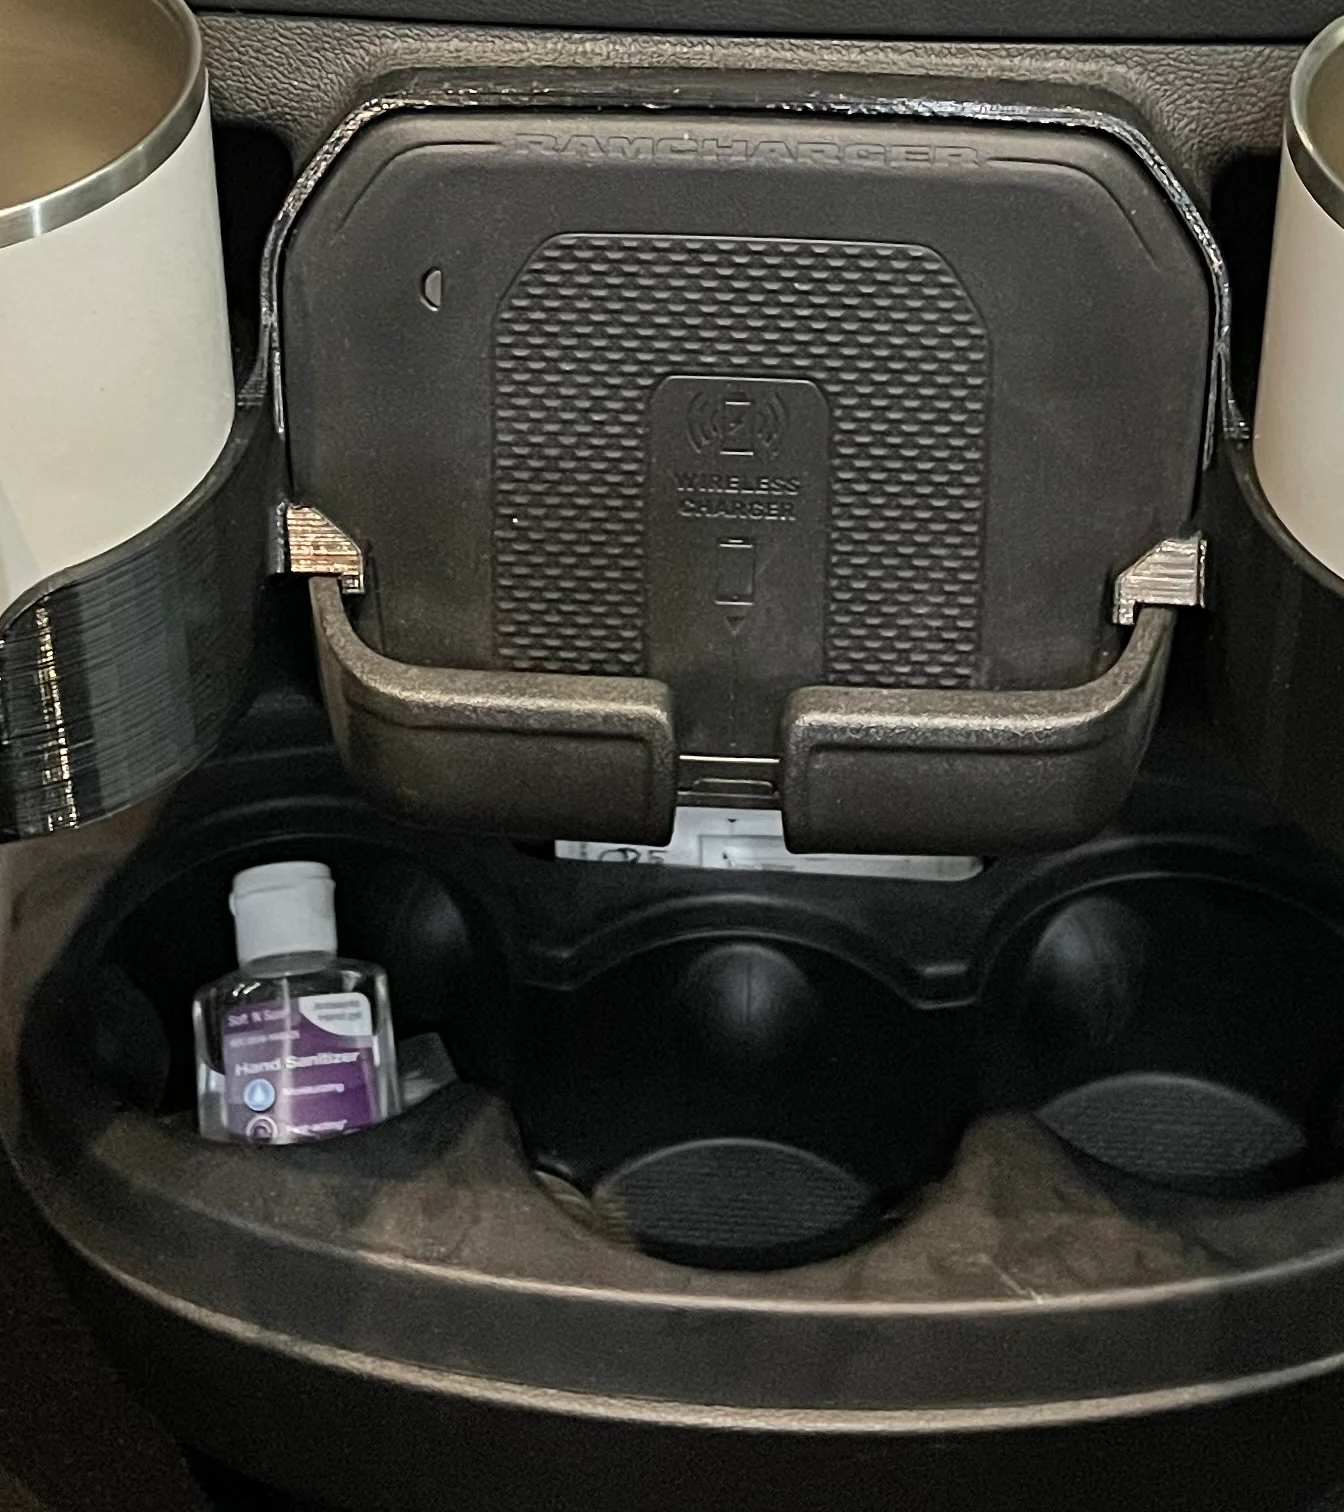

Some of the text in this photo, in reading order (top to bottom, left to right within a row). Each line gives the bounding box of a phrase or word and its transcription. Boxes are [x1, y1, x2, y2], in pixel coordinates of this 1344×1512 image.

[673, 471, 802, 497] WIRELESS
[677, 499, 797, 521] CHARGER
[234, 1051, 361, 1076] Hand Sanitizer
